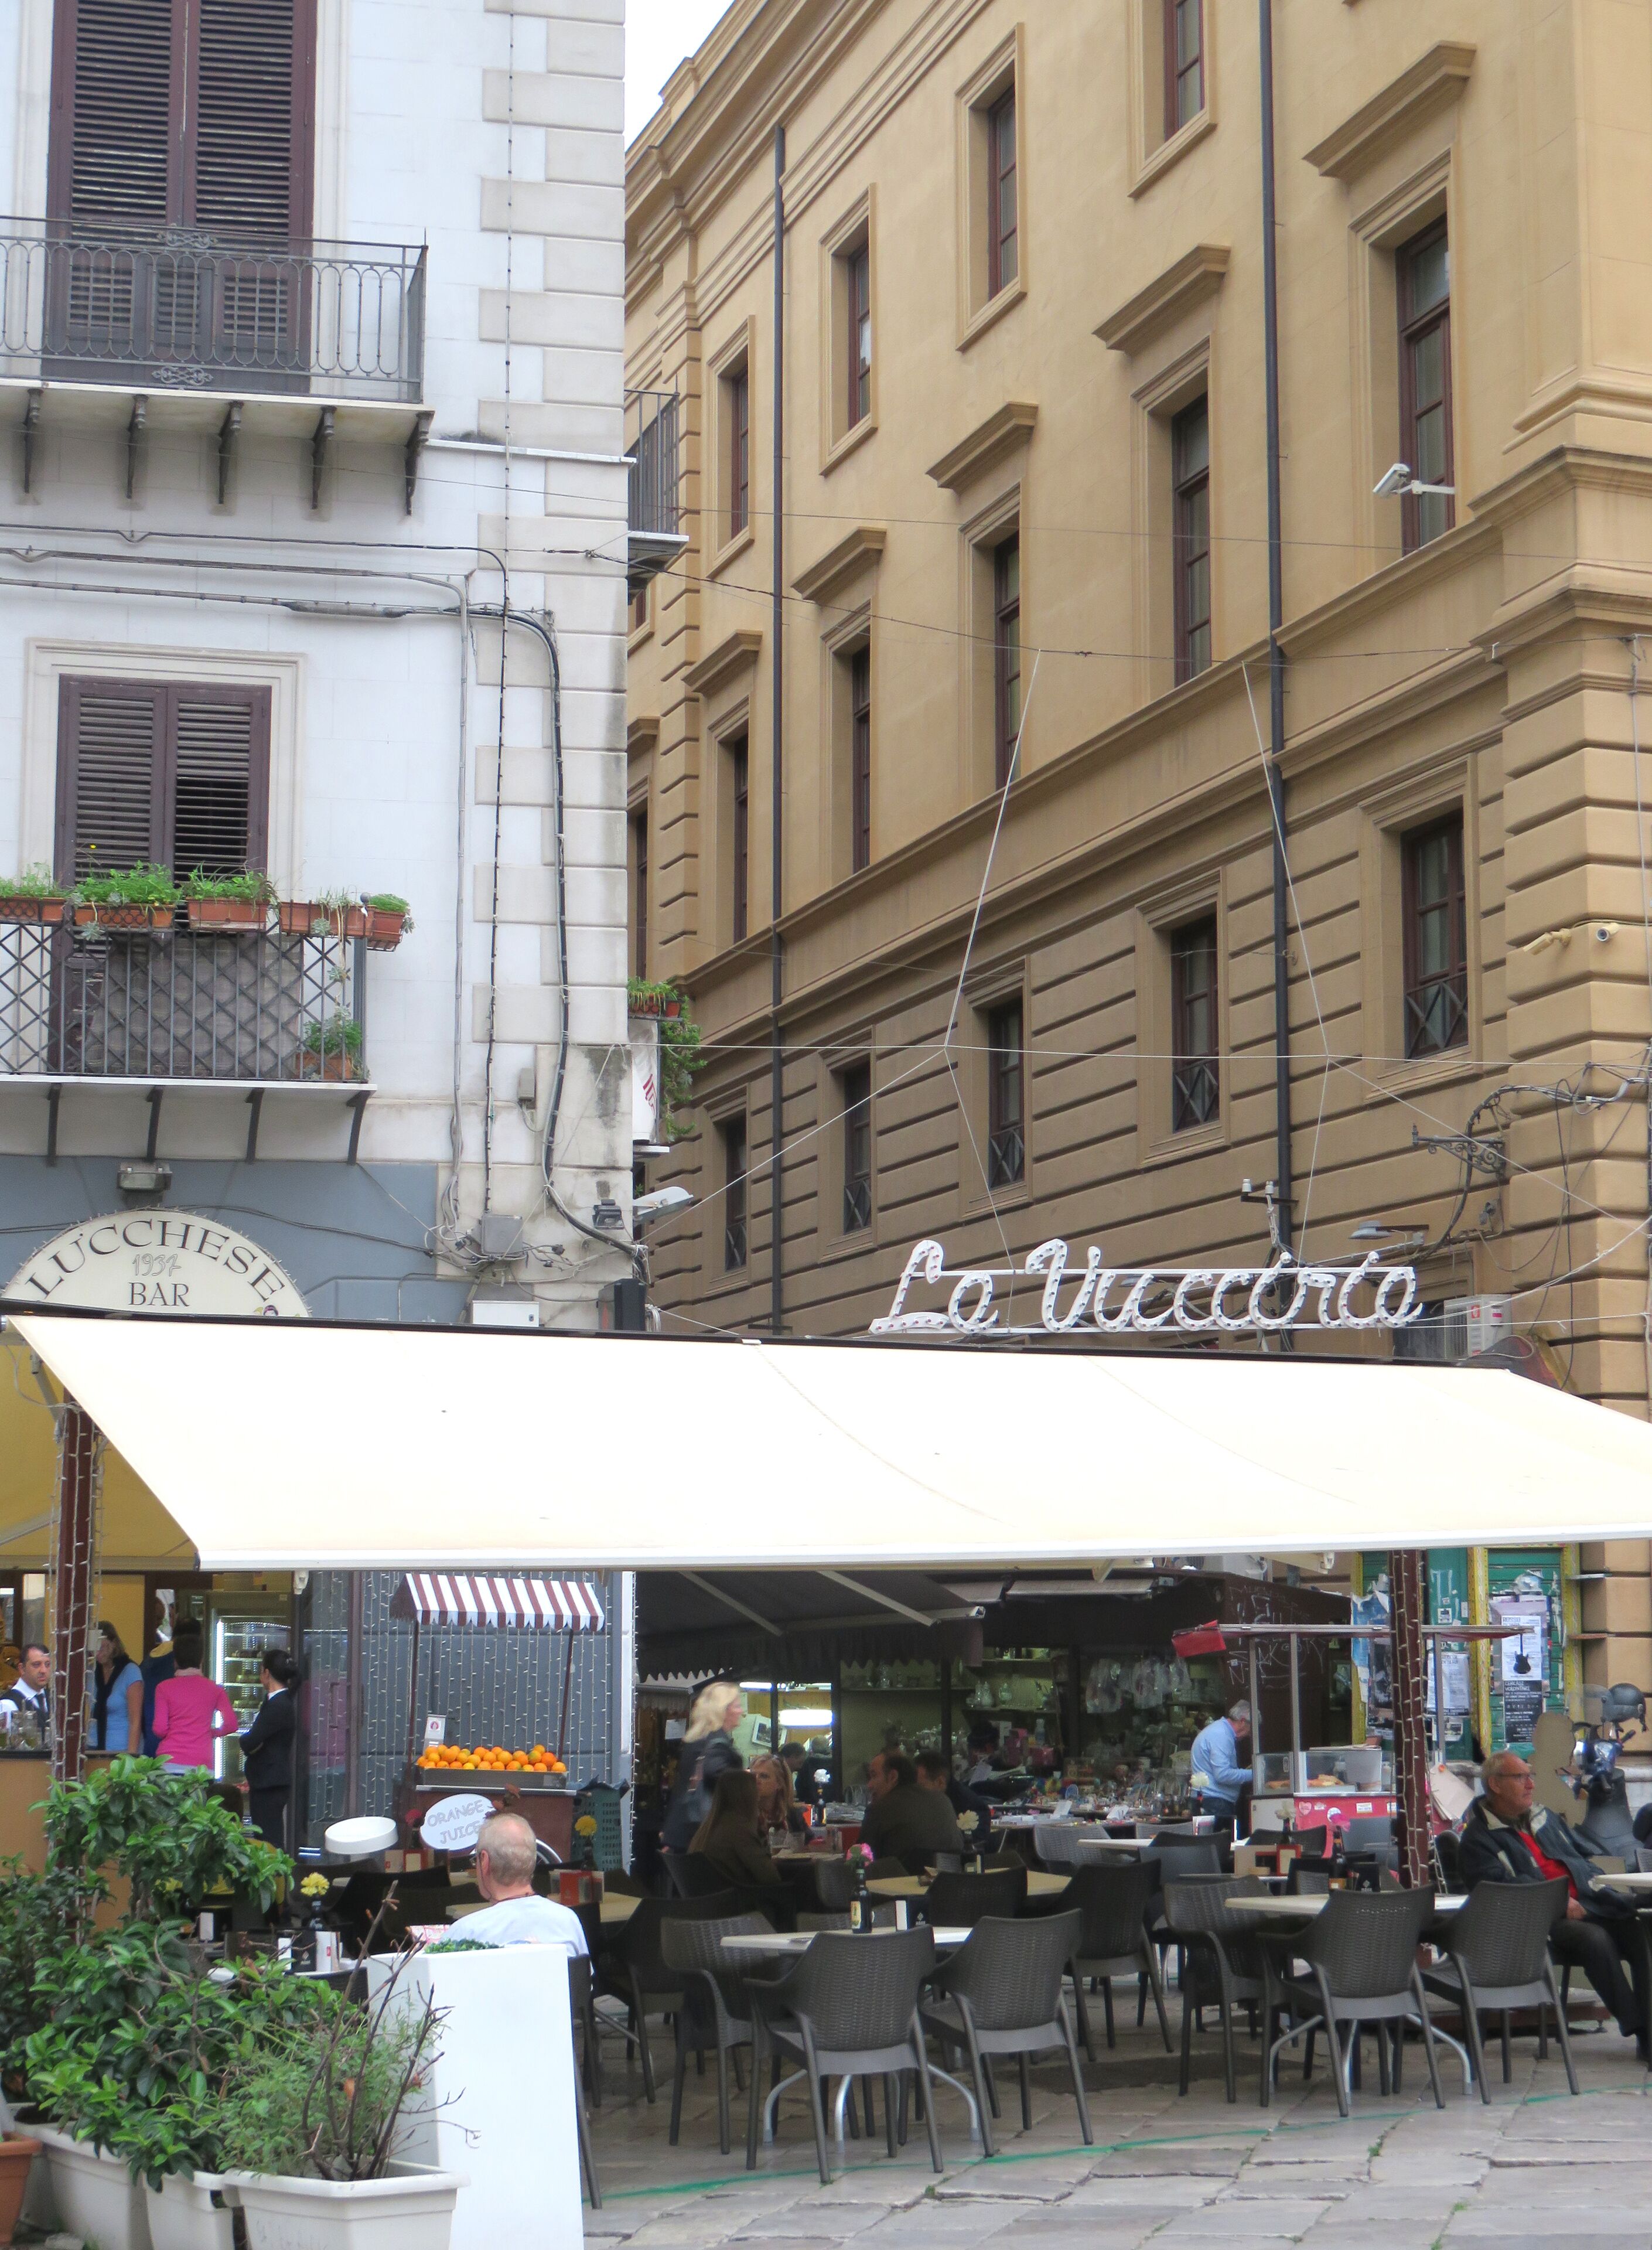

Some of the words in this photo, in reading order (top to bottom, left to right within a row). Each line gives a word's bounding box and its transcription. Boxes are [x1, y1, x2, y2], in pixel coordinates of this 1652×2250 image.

[25, 1219, 285, 1302] LUCCHESE
[132, 1253, 182, 1277] 1937
[128, 1281, 190, 1307] BAR
[868, 1240, 999, 1334] La
[1025, 1238, 1424, 1334] Vucciria
[427, 1799, 484, 1827] ORANGE
[440, 1820, 481, 1845] JUICE
